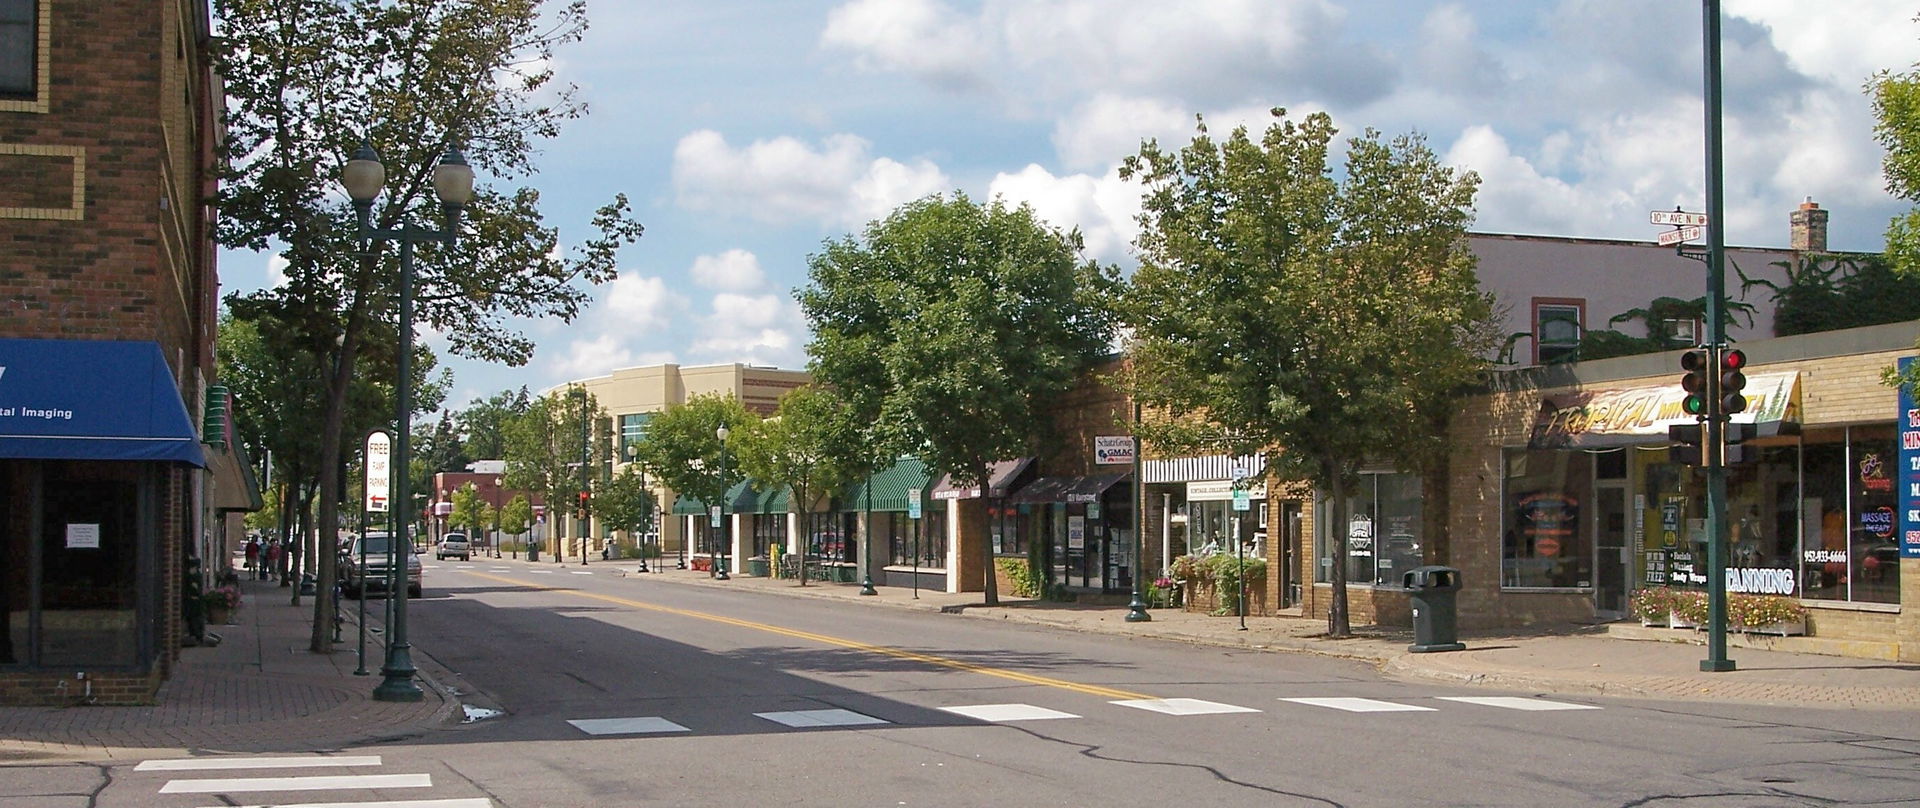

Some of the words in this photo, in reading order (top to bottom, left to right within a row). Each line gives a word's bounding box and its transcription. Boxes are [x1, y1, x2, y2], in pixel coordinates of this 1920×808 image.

[1670, 214, 1683, 223] AVE
[1686, 215, 1692, 224] N
[1660, 229, 1692, 243] MAINSTREET
[22, 406, 73, 420] Imaging
[1545, 396, 1660, 437] TROPICAL
[369, 442, 388, 454] FREE
[1861, 512, 1891, 523] MASSAGE
[1804, 550, 1847, 563] 952-933-6666
[1725, 567, 1796, 595] TANNING
